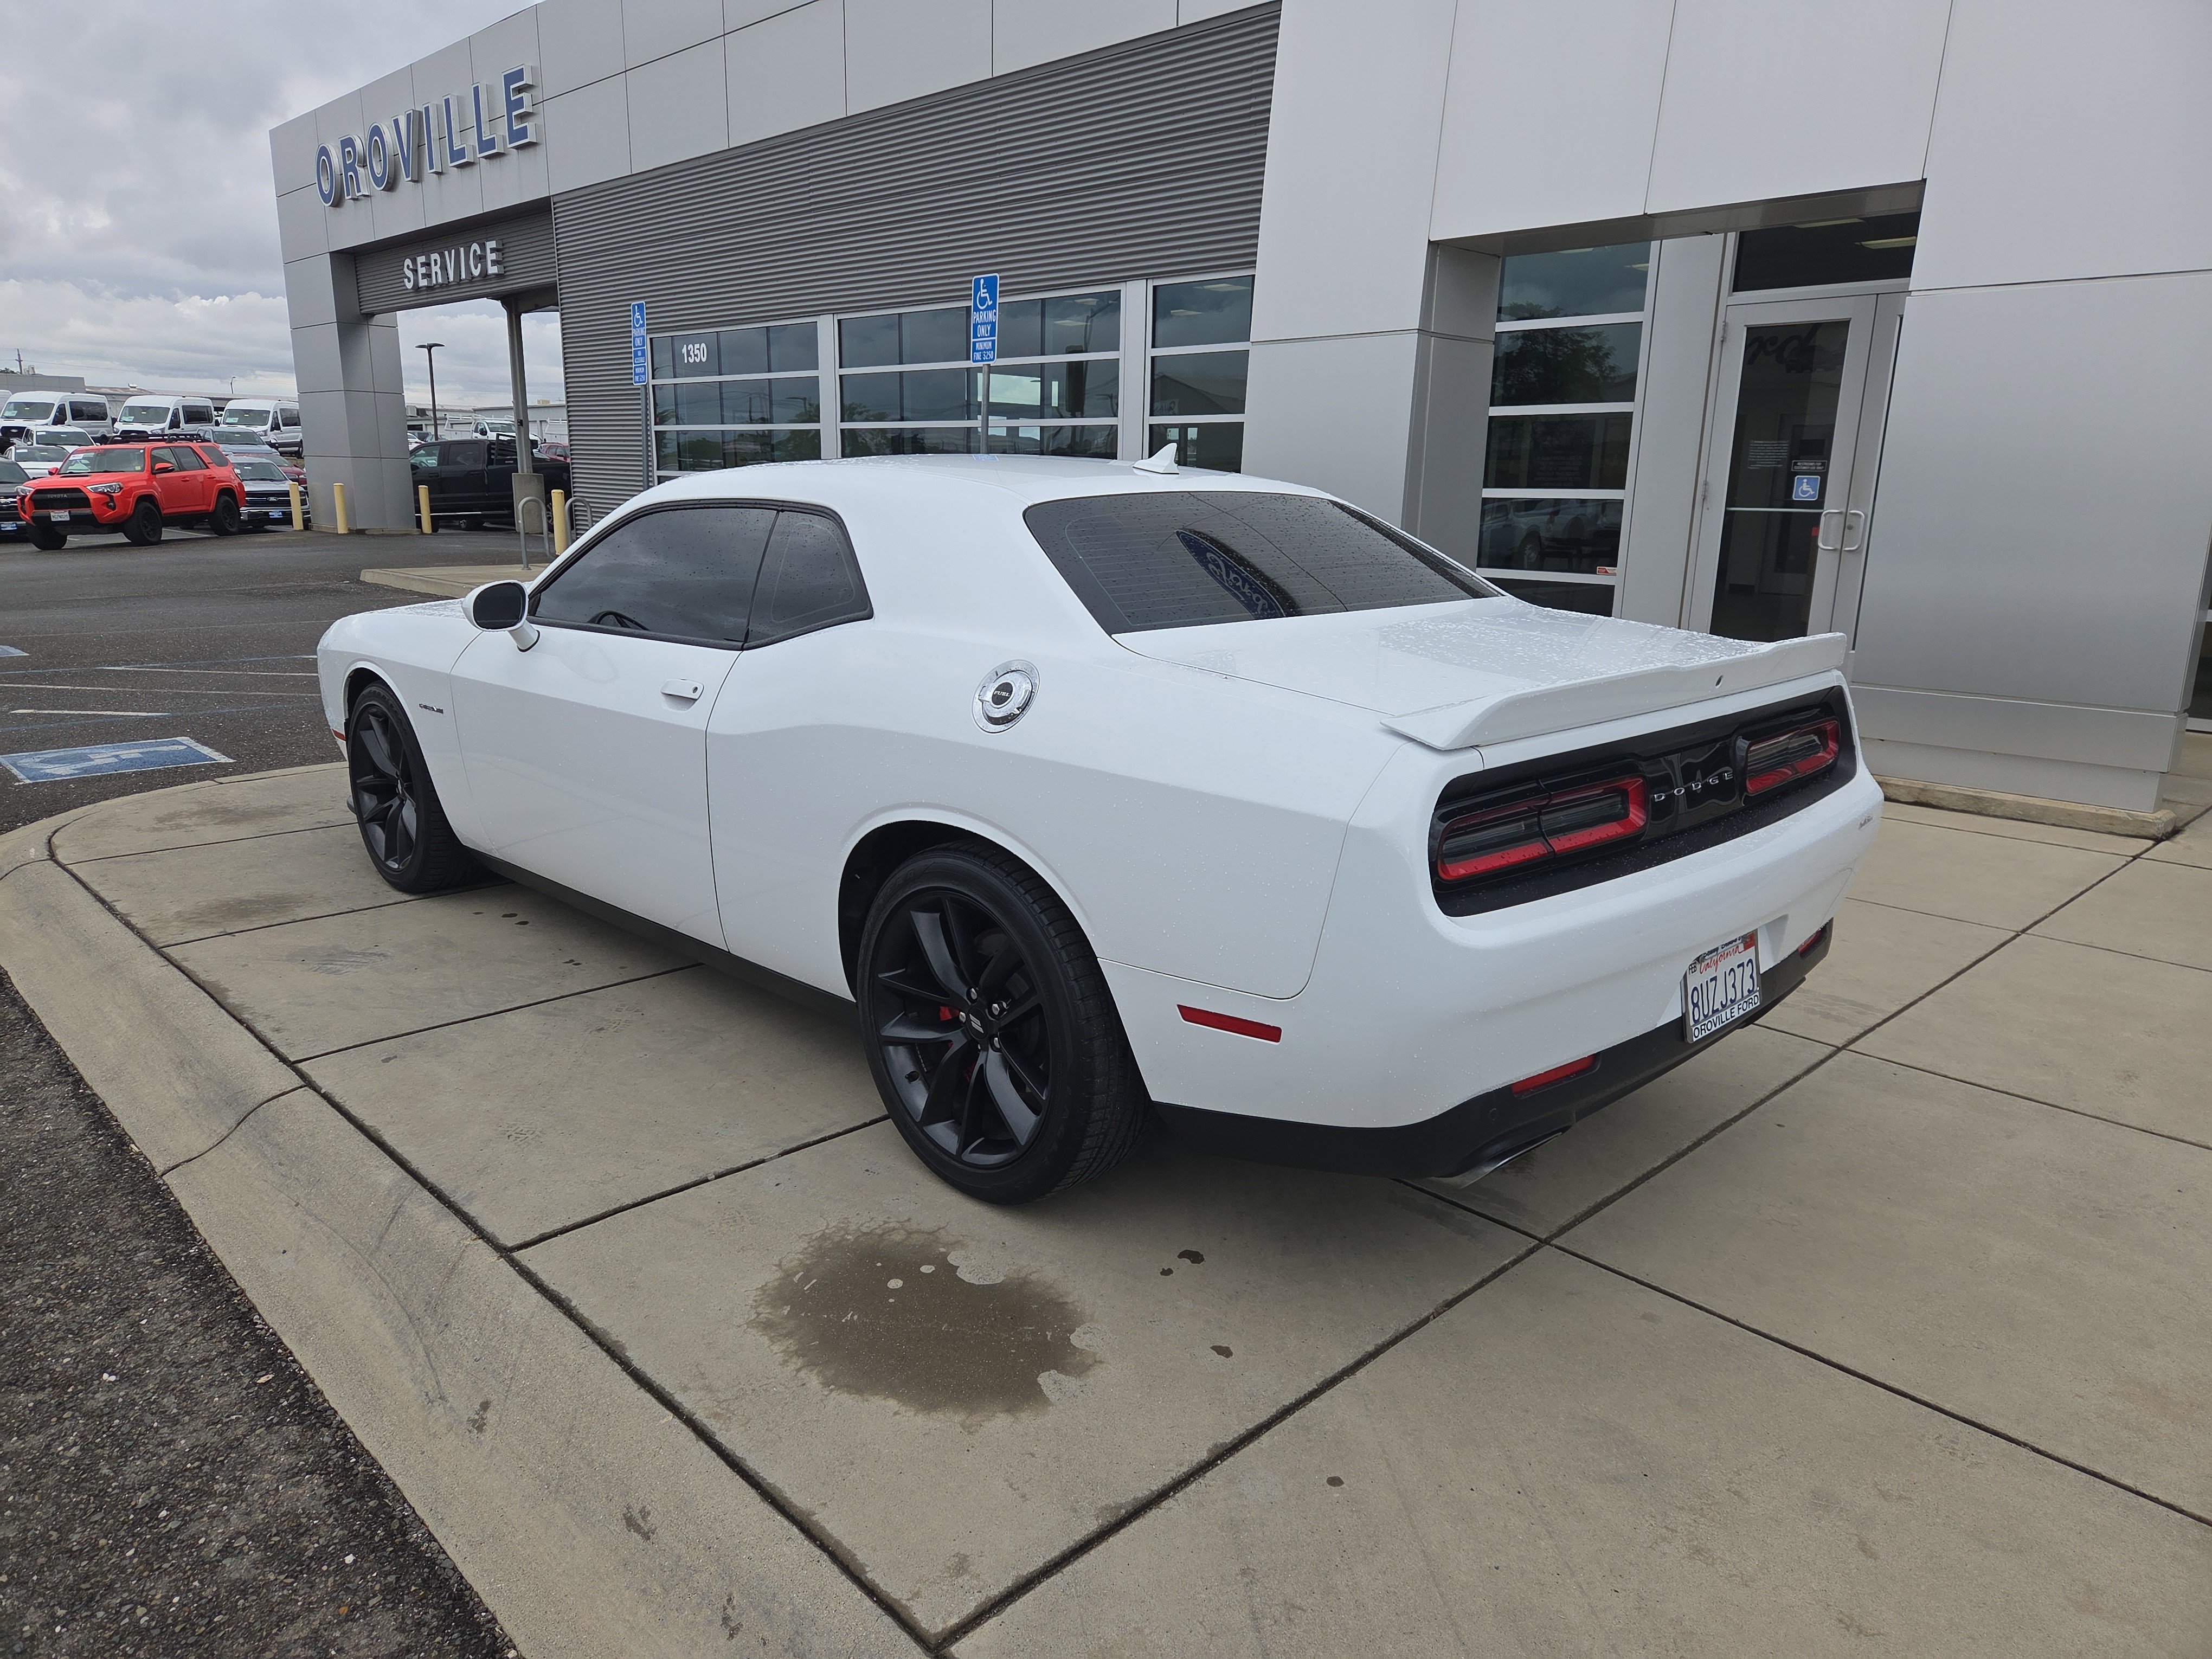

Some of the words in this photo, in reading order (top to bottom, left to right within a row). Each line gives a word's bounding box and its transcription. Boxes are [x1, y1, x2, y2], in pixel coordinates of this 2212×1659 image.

[315, 63, 538, 208] OROVILLE
[403, 240, 503, 290] SERVICE
[973, 310, 996, 324] PARKING
[977, 324, 992, 337] ONLY
[681, 343, 707, 363] 1350
[1654, 771, 1733, 802] DODGE
[1690, 958, 1755, 1024] 8UZJ373
[1693, 1009, 1735, 1039] OROVILLE
[1737, 994, 1759, 1015] FORD
